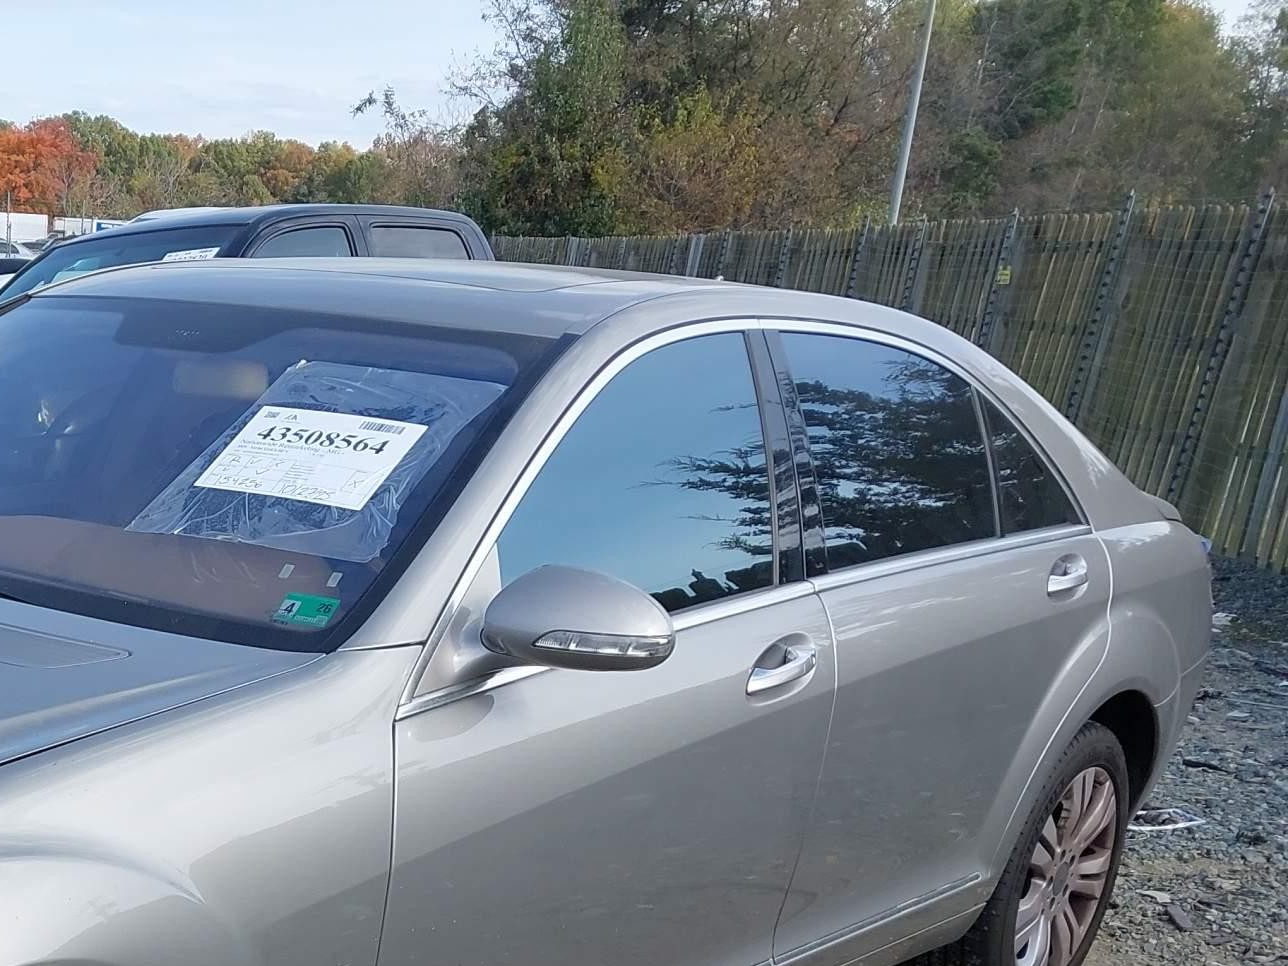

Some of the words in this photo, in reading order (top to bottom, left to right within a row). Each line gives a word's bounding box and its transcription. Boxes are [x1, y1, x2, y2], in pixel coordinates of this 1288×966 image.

[257, 425, 390, 455] 43508564
[279, 602, 296, 615] 4
[317, 603, 332, 614] 26
